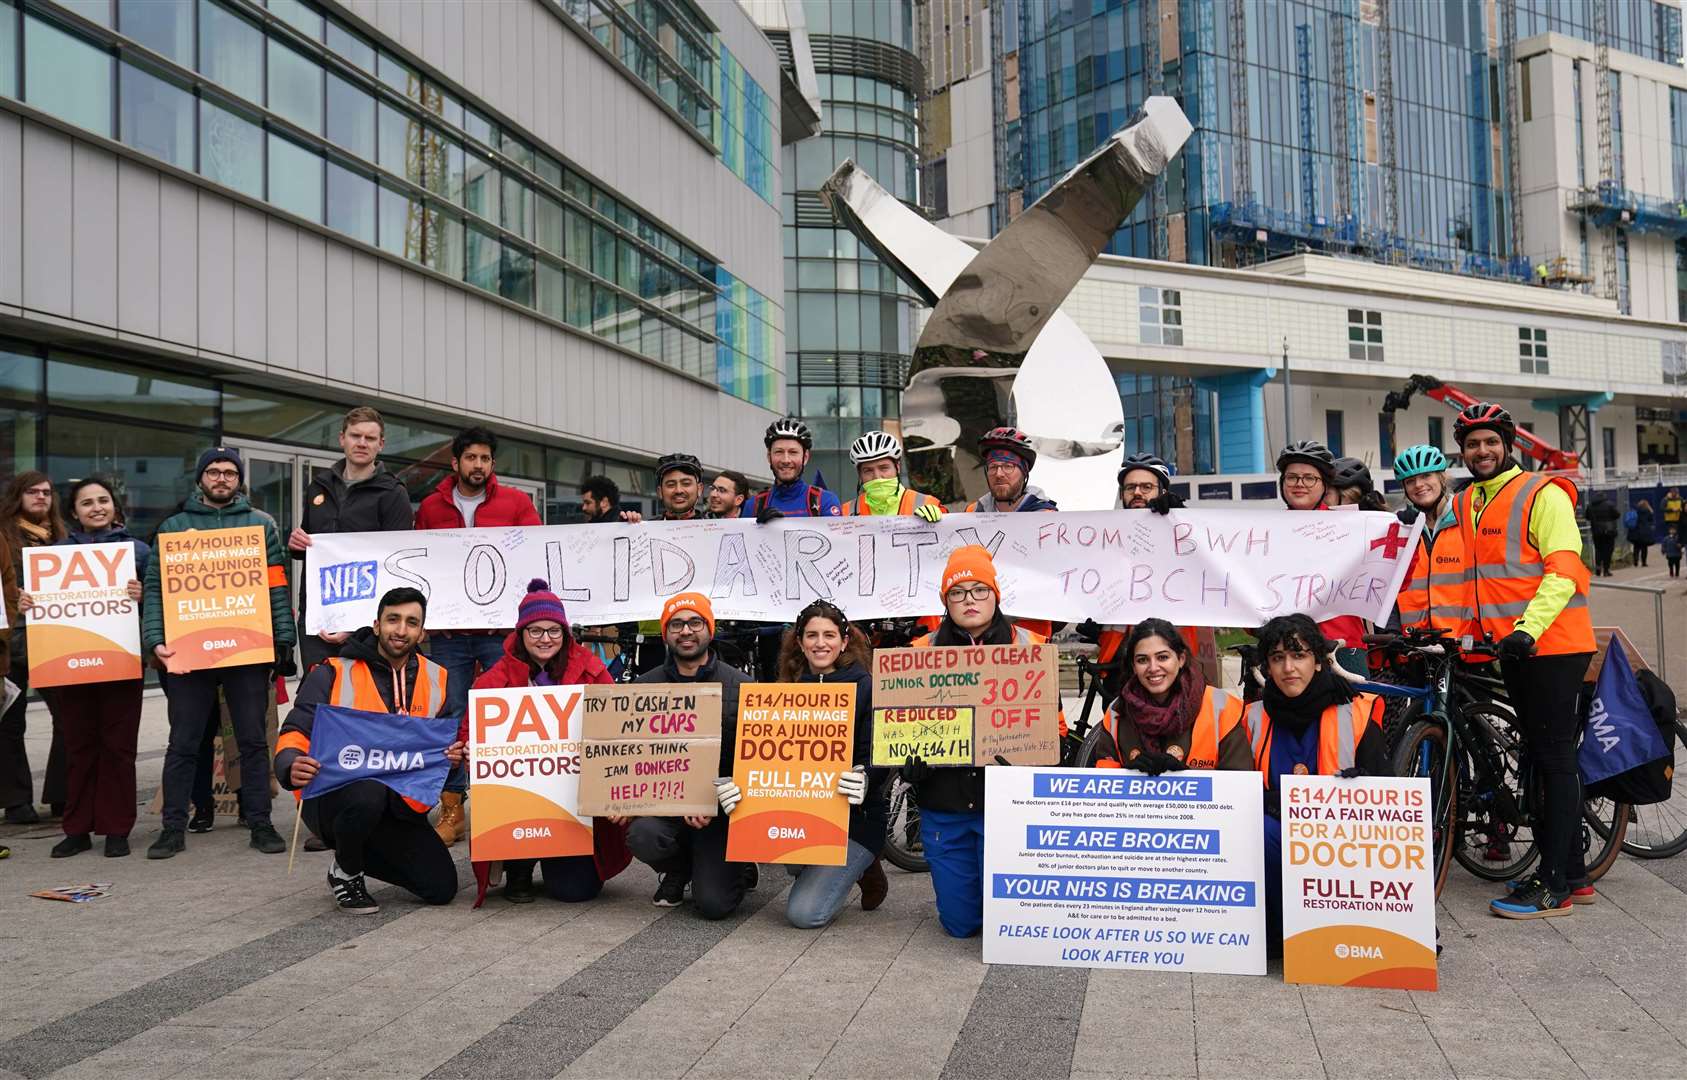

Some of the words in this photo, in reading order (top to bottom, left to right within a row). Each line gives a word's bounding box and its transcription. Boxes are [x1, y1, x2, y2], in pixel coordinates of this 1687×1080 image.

[166, 535, 243, 552] £14/HOUR
[246, 534, 260, 545] IS
[165, 553, 189, 563] NOT
[192, 551, 200, 561] A
[202, 549, 228, 559] FAIR
[229, 546, 261, 557] WAGE
[324, 564, 375, 600] NHS
[1038, 522, 1123, 550] FROM
[1173, 522, 1270, 557] BWH
[29, 548, 128, 592] PAY
[167, 563, 195, 575] FOR
[199, 562, 208, 573] A
[210, 558, 261, 573] JUNIOR
[952, 569, 973, 581] BMA
[167, 570, 263, 594] DOCTOR
[1058, 567, 1100, 595] TO
[1130, 564, 1230, 607] BCH
[1257, 571, 1388, 612] STRIKER
[31, 590, 107, 603] RESTORATION
[177, 597, 223, 614] FULL
[225, 593, 256, 609] PAY
[676, 599, 696, 608] BMA
[33, 599, 132, 620] DOCTORS
[178, 609, 236, 621] RESTORATION
[237, 608, 257, 616] NOW
[214, 639, 237, 649] BMA
[79, 657, 104, 668] BMA
[879, 650, 958, 674] REDUCED
[963, 647, 986, 666] TO
[991, 644, 1042, 665] CLEAR
[880, 677, 924, 691] JUNIOR
[929, 672, 981, 688] DOCTORS
[982, 670, 1046, 705] 30%
[584, 697, 607, 713] TRY
[611, 696, 629, 712] TO
[635, 696, 668, 712] CASH
[671, 696, 696, 710] IN
[744, 692, 831, 708] £14/HOUR
[834, 693, 849, 707] IS
[475, 692, 582, 744] PAY
[621, 717, 644, 734] MY
[649, 713, 698, 735] CLAPS
[743, 710, 769, 721] NOT
[771, 710, 780, 721] A
[783, 710, 810, 721] FAIR
[812, 710, 849, 721] WAGE
[884, 708, 957, 723] REDUCED
[991, 708, 1040, 729] OFF
[742, 724, 773, 737] FOR
[776, 724, 787, 737] A
[789, 724, 848, 739] JUNIOR
[883, 729, 904, 739] WAS
[1588, 698, 1621, 753] BMA
[476, 744, 557, 757] RESTORATION
[585, 744, 643, 758] BANKERS
[649, 742, 689, 755] THINK
[740, 739, 847, 762] DOCTOR
[889, 742, 920, 758] NOW
[367, 748, 425, 771] BMA
[476, 755, 581, 779] DOCTORS
[635, 758, 691, 776] BONKERS
[748, 770, 796, 788] FULL
[800, 771, 836, 789] PAY
[1049, 778, 1080, 794] WE
[1083, 778, 1124, 795] ARE
[1128, 780, 1199, 796] BROKE
[611, 783, 648, 801] HELP
[747, 788, 810, 798] RESTORATION
[812, 790, 834, 799] NOW
[1289, 786, 1398, 806] £14/HOUR
[1404, 789, 1423, 807] IS
[1142, 802, 1164, 810] average
[1289, 806, 1321, 820] NOT
[1325, 807, 1336, 820] A
[1340, 808, 1374, 821] FAIR
[1378, 809, 1423, 823] WAGE
[526, 827, 552, 838] BMA
[780, 828, 806, 839] BMA
[1039, 829, 1070, 846] WE
[1074, 830, 1117, 847] ARE
[1121, 831, 1210, 850] BROKEN
[1289, 822, 1328, 839] FOR
[1334, 824, 1347, 839] A
[1350, 824, 1424, 842] JUNIOR
[1080, 852, 1111, 860] exhaustion
[1176, 855, 1197, 863] highest
[1289, 841, 1425, 870] DOCTOR
[1004, 878, 1060, 896] YOUR
[1065, 880, 1107, 898] NHS
[1112, 881, 1132, 898] IS
[1137, 882, 1246, 902] BREAKING
[1302, 878, 1364, 899] FULL
[1370, 880, 1414, 901] PAY
[1303, 899, 1383, 912] RESTORATION
[1386, 902, 1414, 913] NOW
[999, 924, 1049, 938] PLEASE
[1053, 926, 1092, 940] LOOK
[1094, 928, 1140, 942] AFTER
[1144, 930, 1163, 943] US
[1167, 931, 1186, 944] SO
[1191, 931, 1215, 945] WE
[1219, 933, 1250, 946] CAN
[1061, 948, 1101, 962] LOOK
[1104, 949, 1149, 963] AFTER
[1153, 951, 1185, 965] YOU
[1351, 945, 1383, 960] BMA
